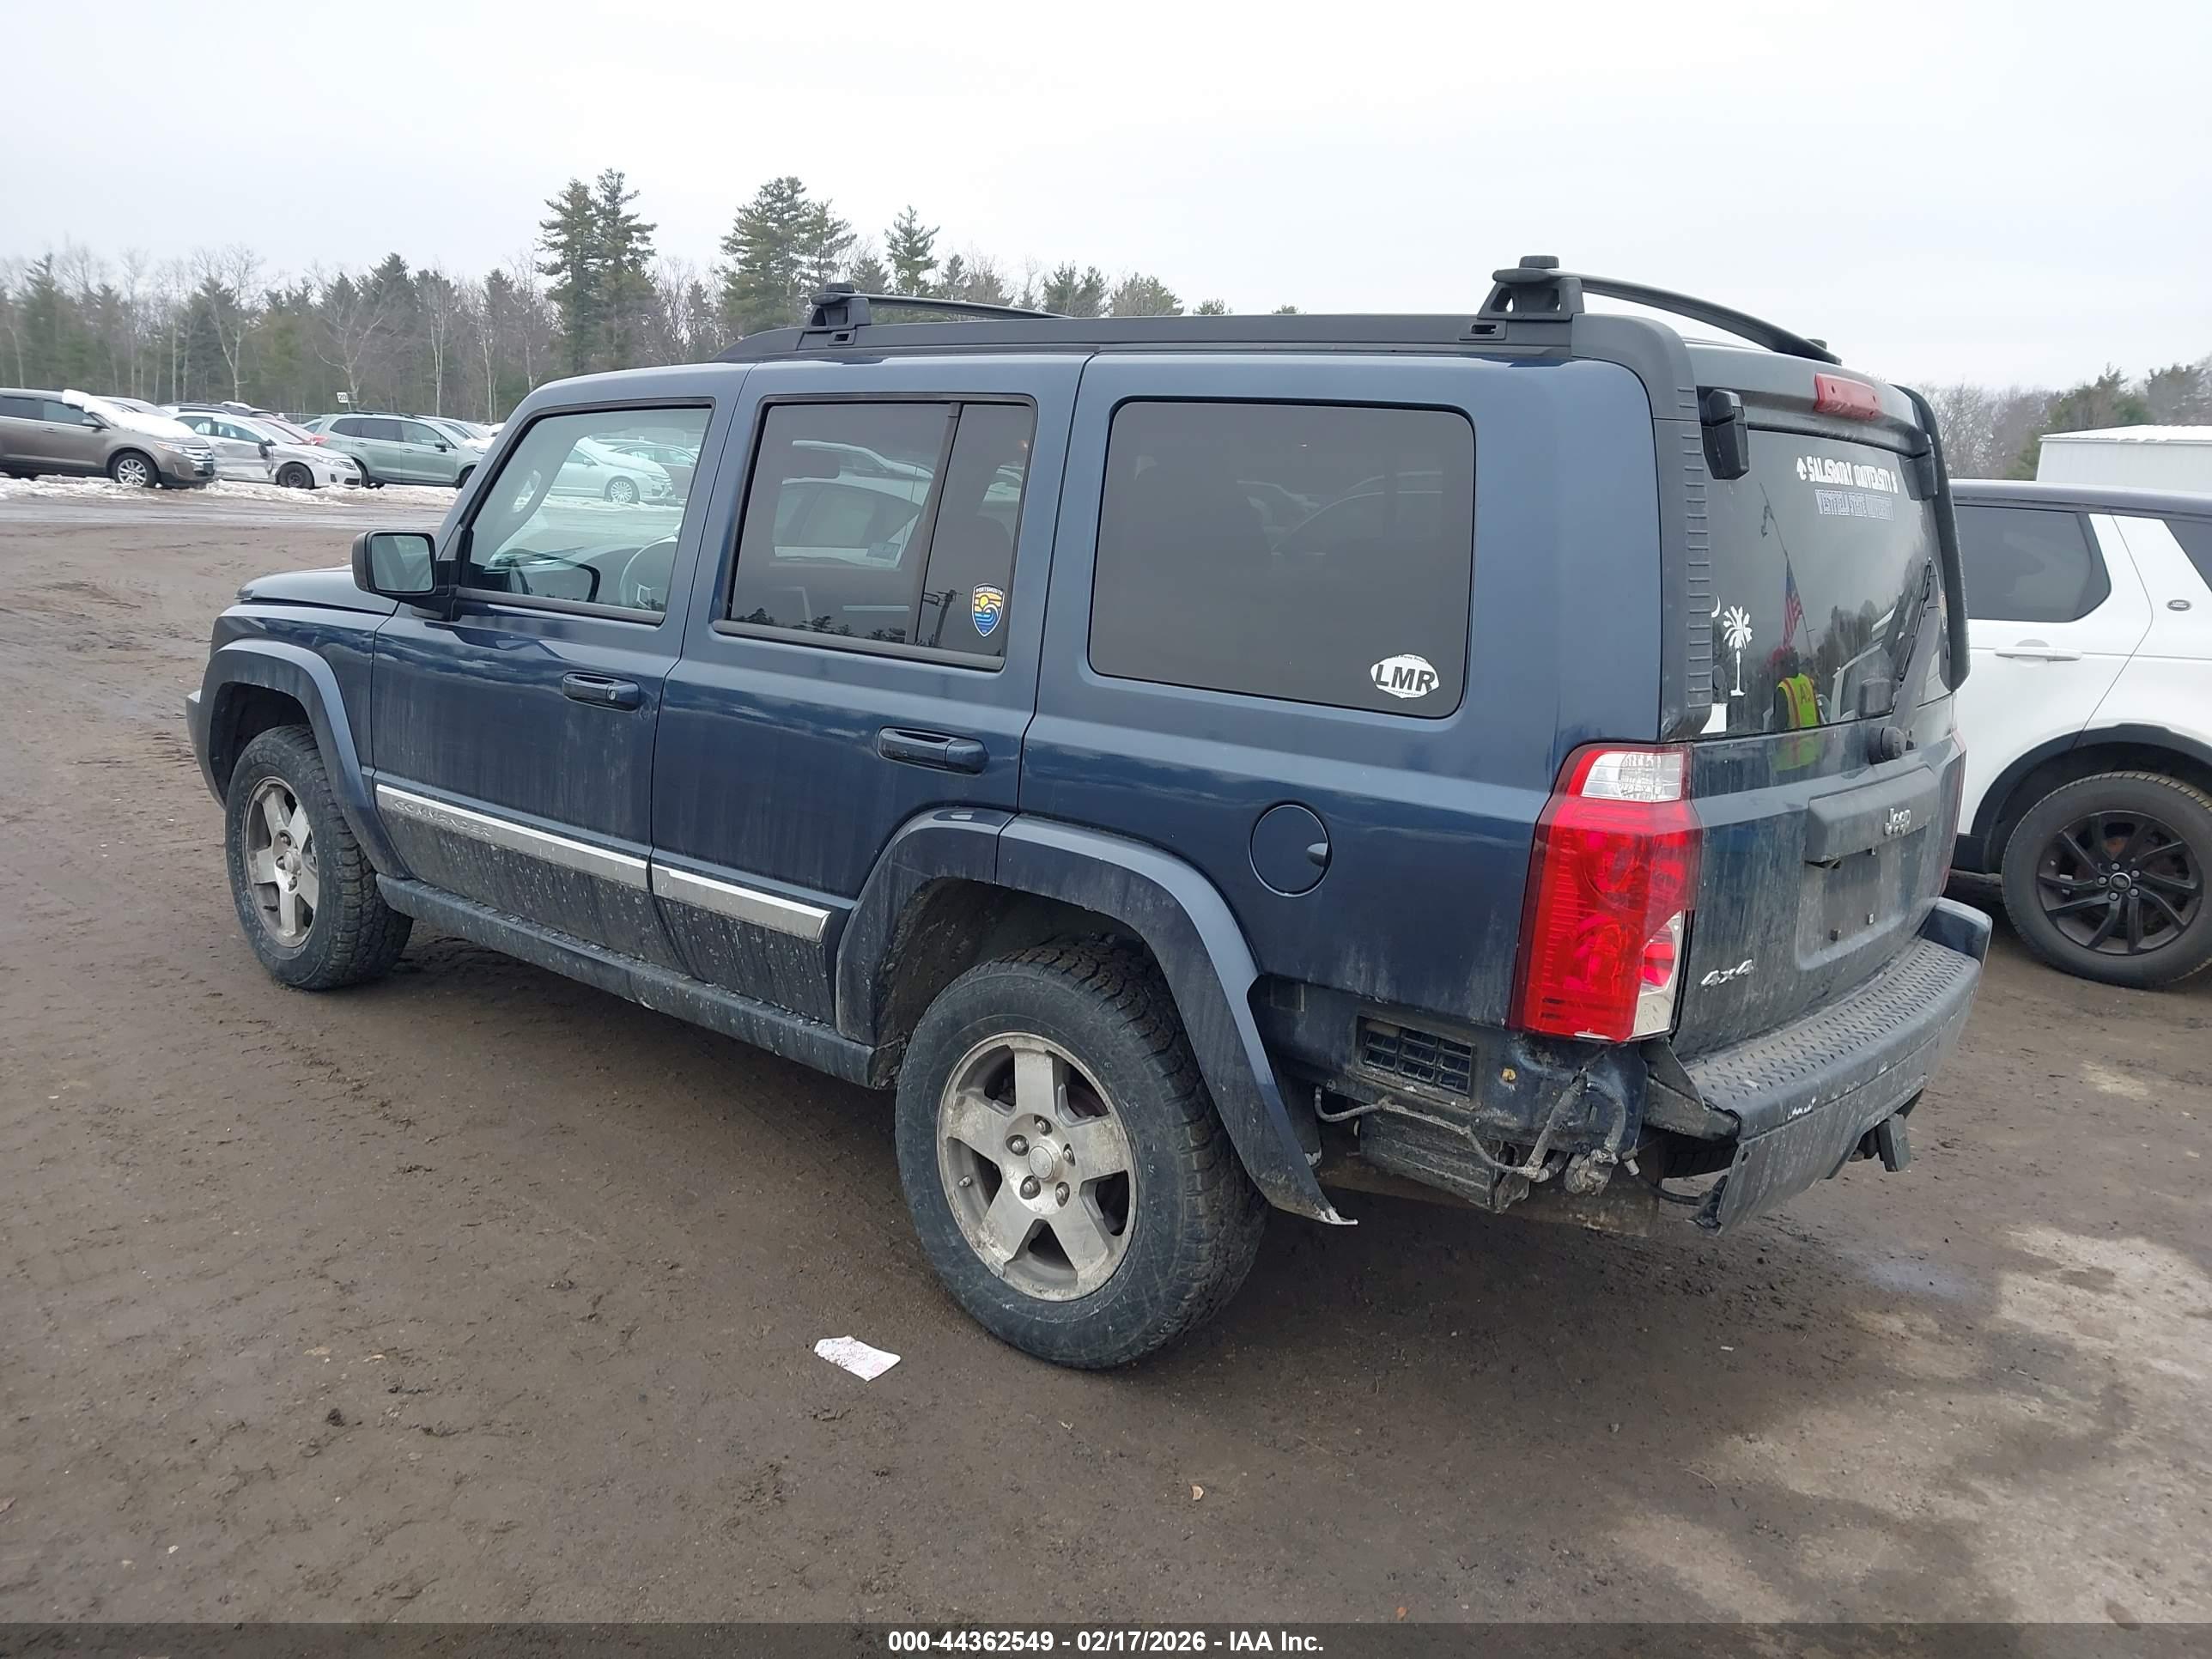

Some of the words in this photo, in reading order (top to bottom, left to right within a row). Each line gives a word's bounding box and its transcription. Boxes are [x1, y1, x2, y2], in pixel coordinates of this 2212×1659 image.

[1375, 664, 1436, 692] LMR
[394, 799, 492, 838] COMMANDER
[1884, 807, 1911, 836] Jeep
[1700, 958, 1753, 987] 4x4
